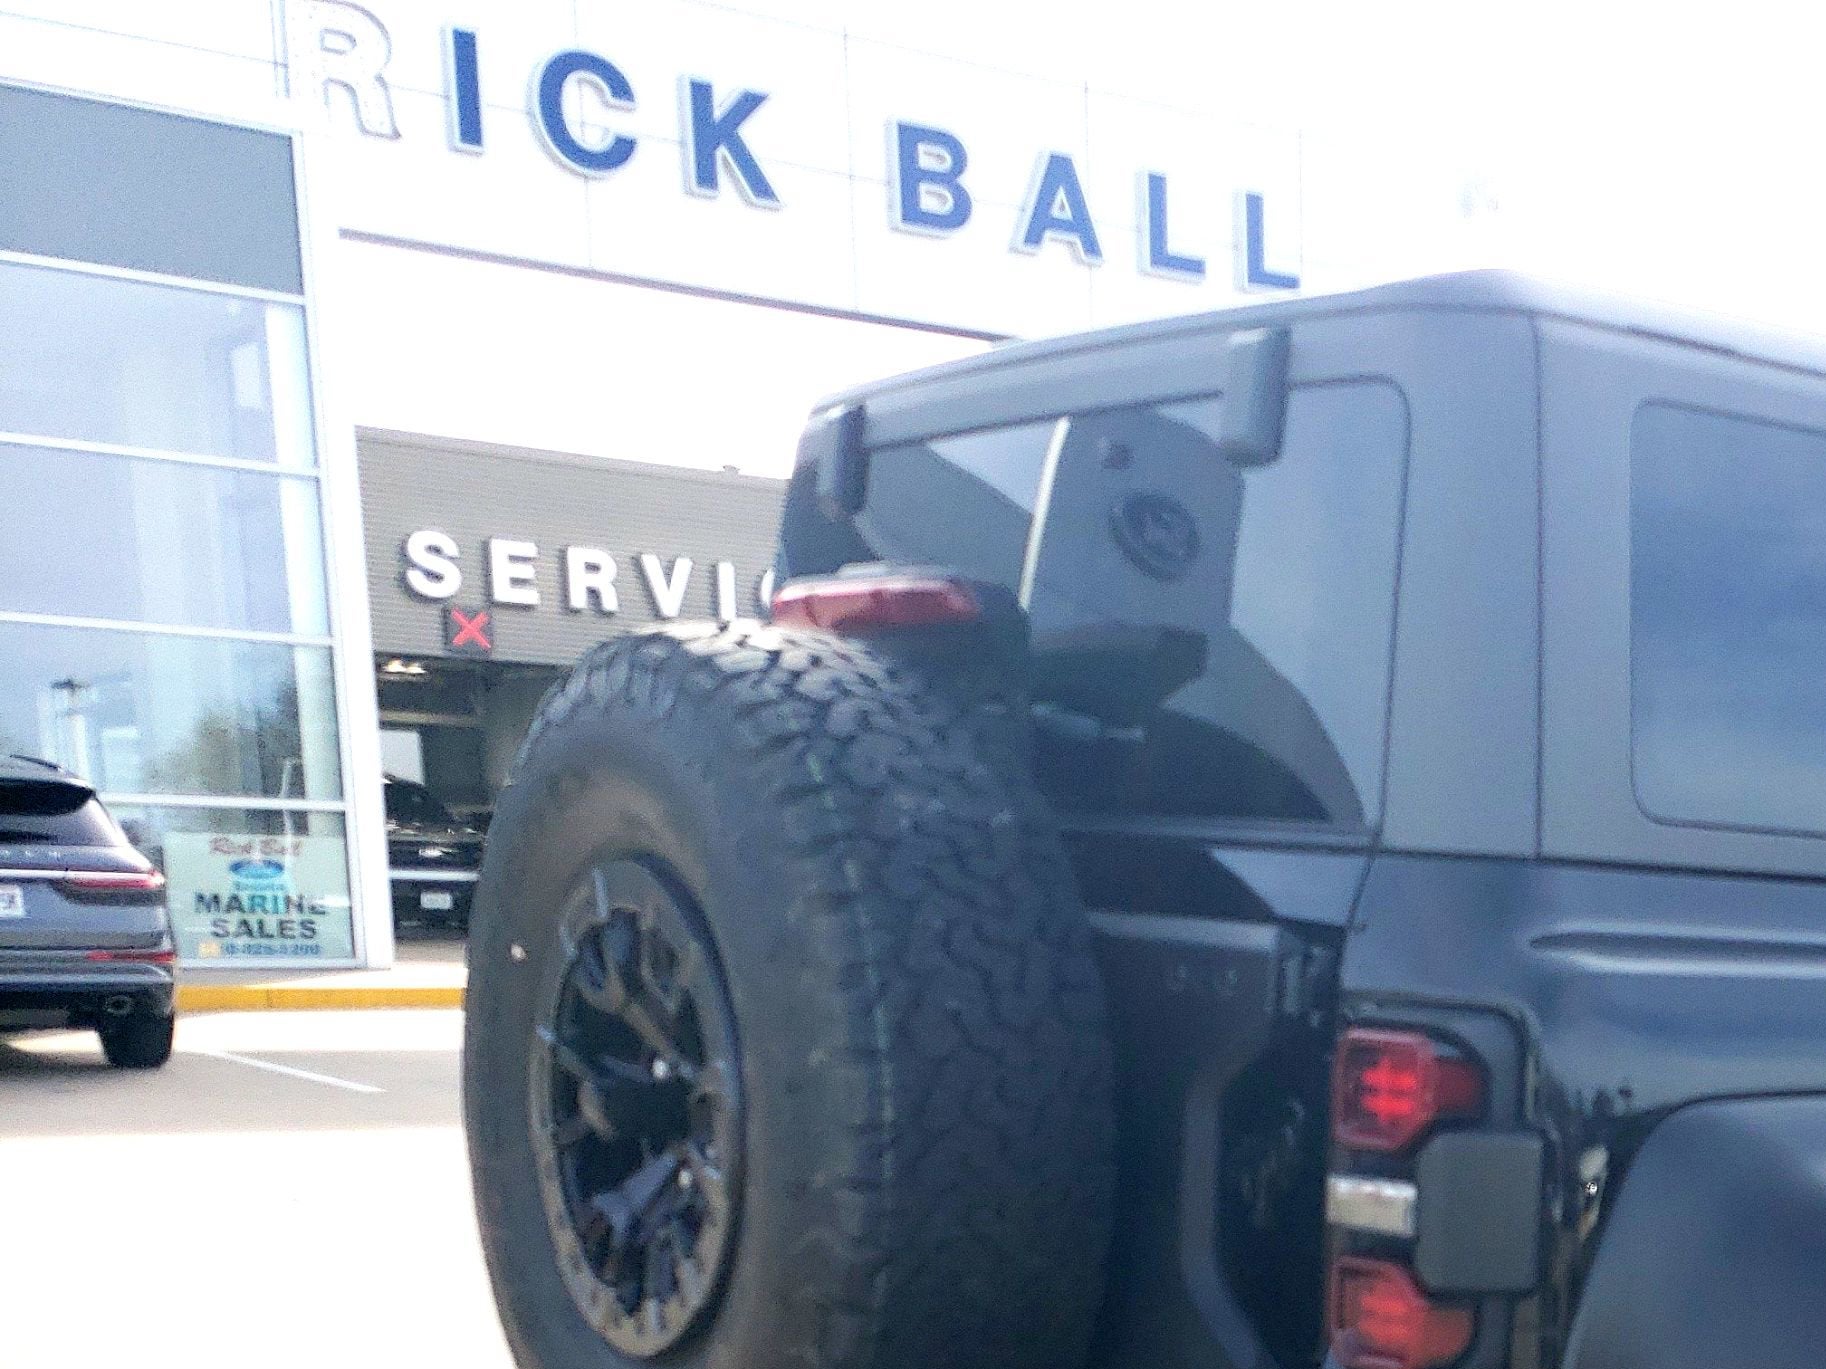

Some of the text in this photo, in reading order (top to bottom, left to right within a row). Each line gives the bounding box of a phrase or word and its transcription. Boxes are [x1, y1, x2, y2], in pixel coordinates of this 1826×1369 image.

[296, 0, 1301, 291] RICK BALL
[210, 918, 316, 939] SALES
